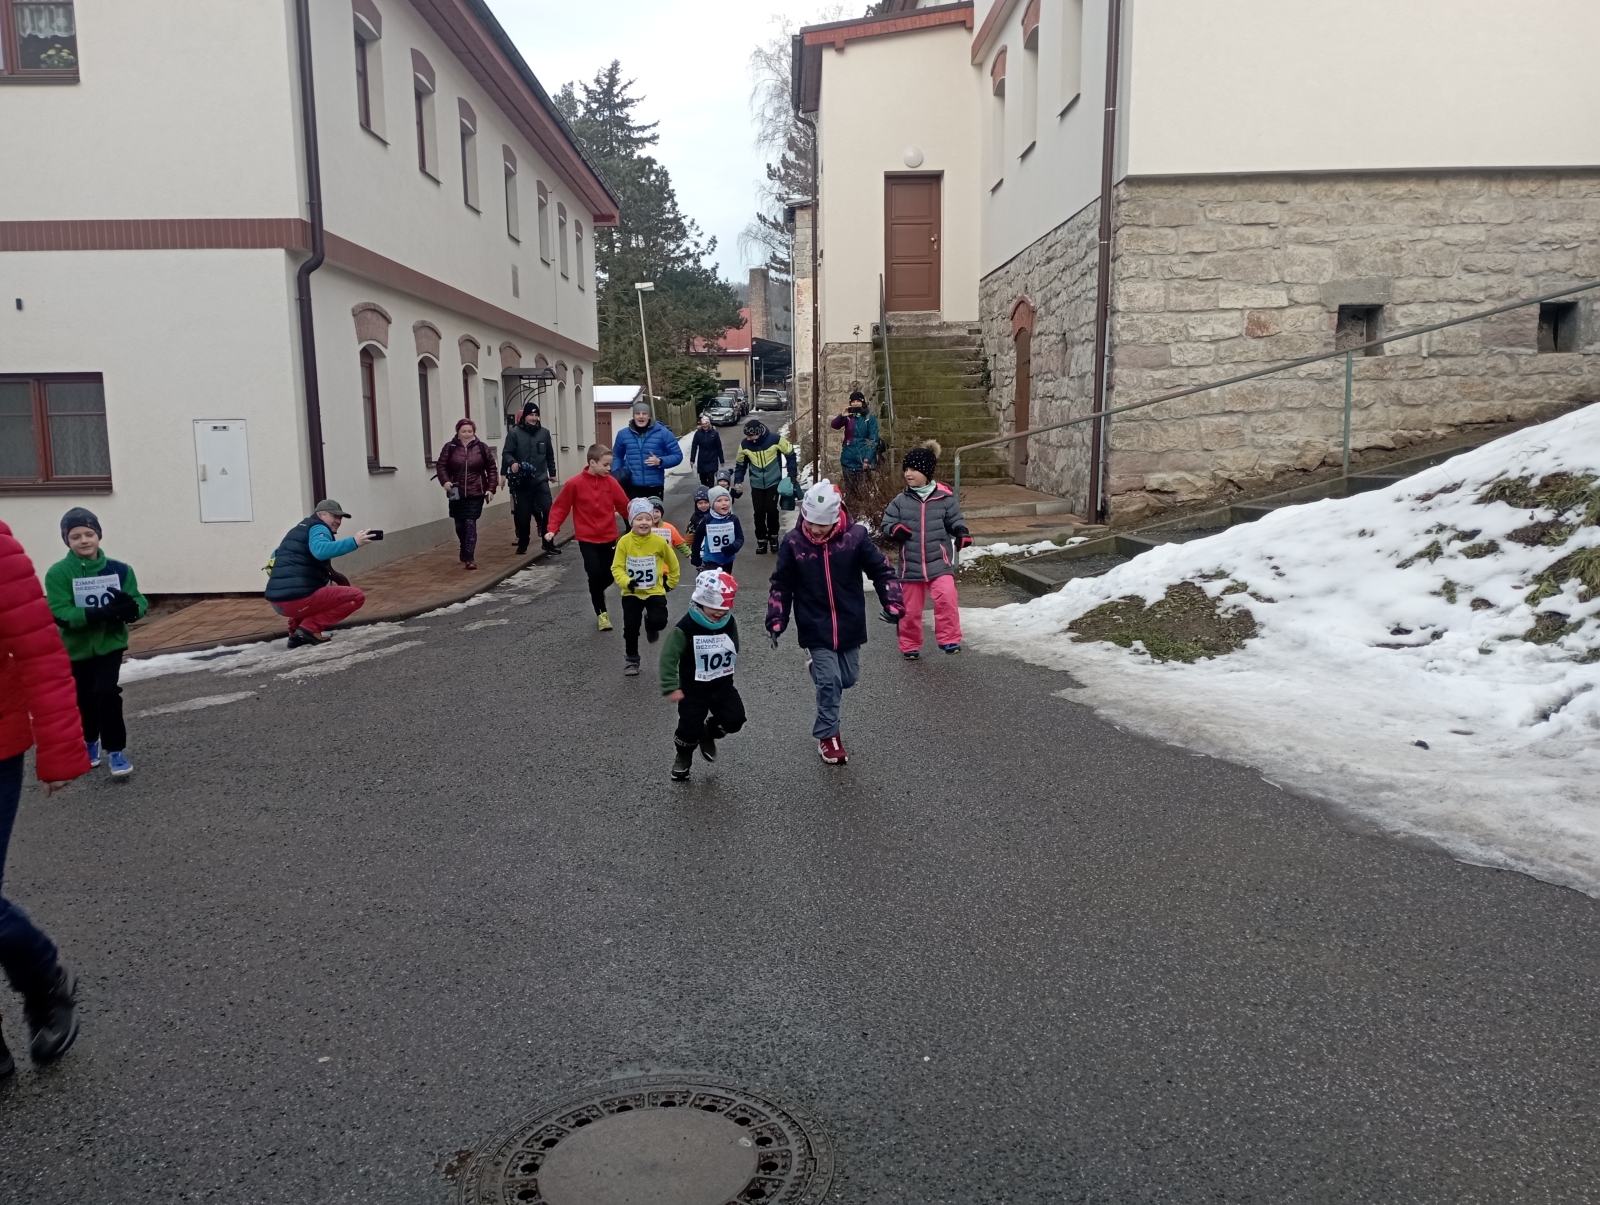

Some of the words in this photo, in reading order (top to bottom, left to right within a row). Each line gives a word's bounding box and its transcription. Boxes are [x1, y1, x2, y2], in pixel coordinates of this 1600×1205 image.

[713, 534, 730, 547] 96
[85, 593, 112, 608] 90
[700, 651, 734, 672] 103
